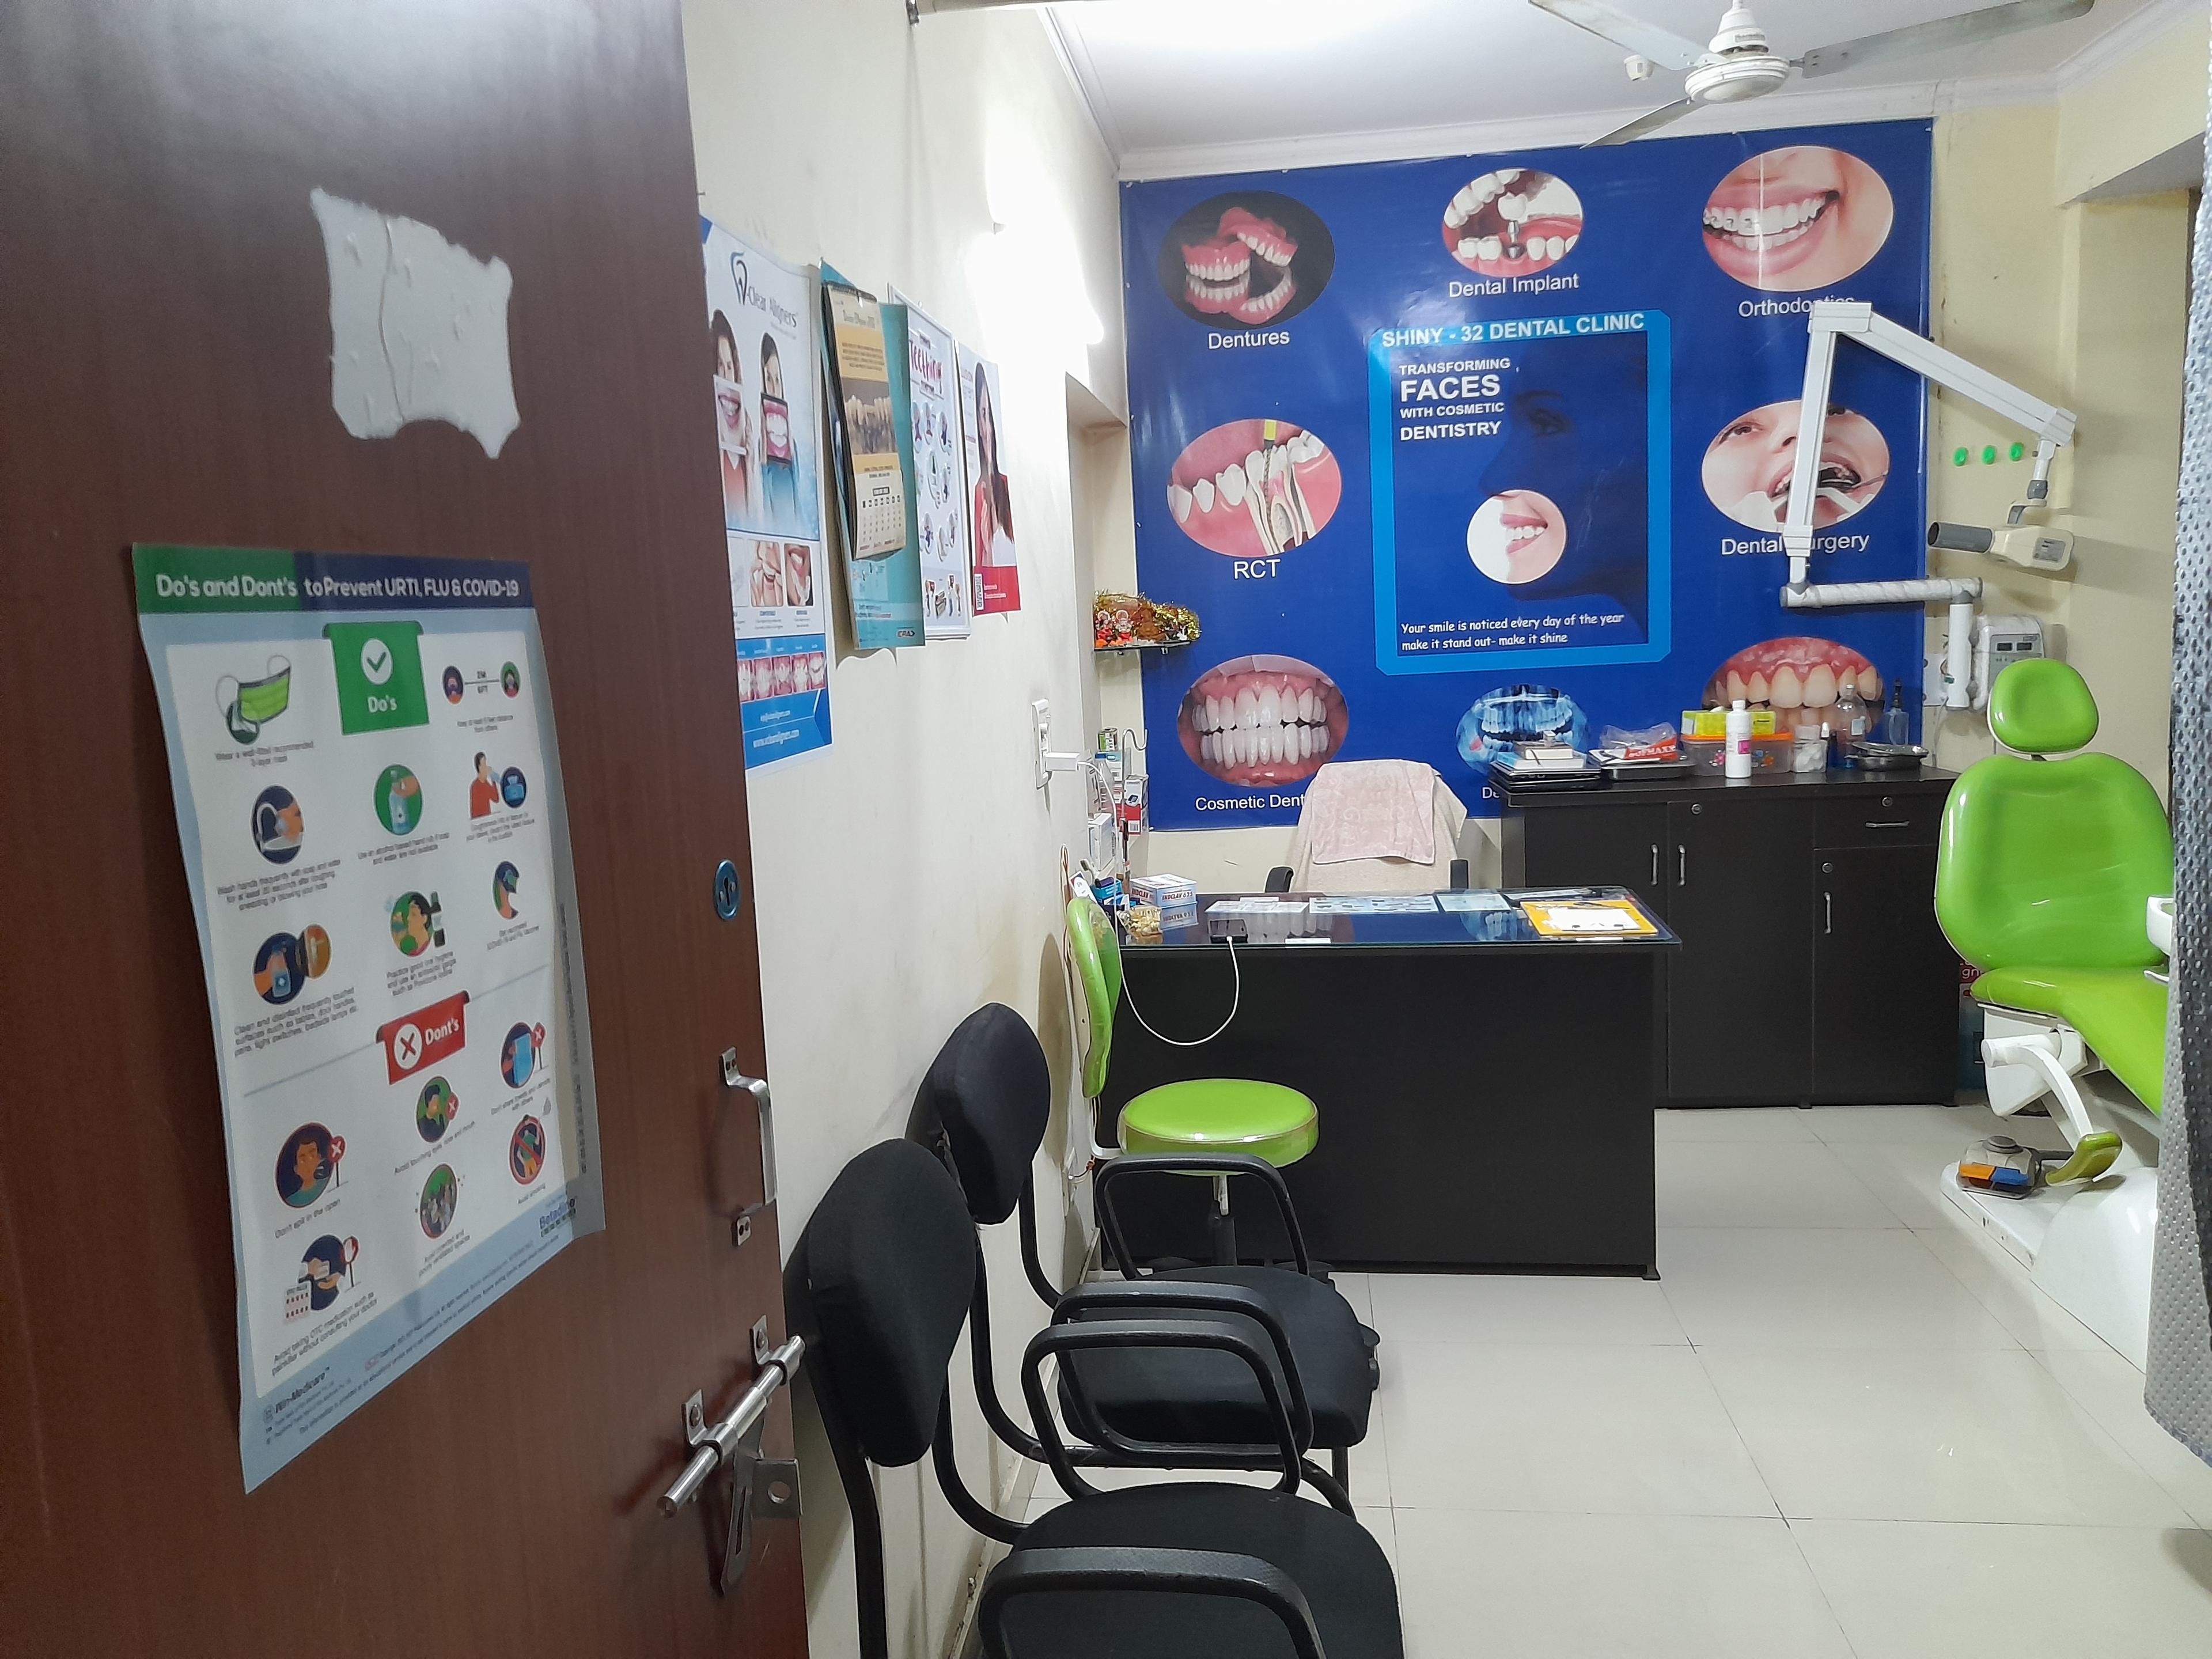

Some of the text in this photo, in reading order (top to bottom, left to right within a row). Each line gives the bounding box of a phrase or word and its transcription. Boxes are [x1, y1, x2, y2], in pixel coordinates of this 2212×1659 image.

[1449, 273, 1579, 298] Dental Implant
[1738, 294, 1855, 317] Orthodo
[1382, 327, 1443, 347] SHINY
[1461, 324, 1484, 342] 32
[1490, 319, 1571, 339] DENTAL
[1576, 313, 1645, 334] CLINIC
[1208, 331, 1290, 350] Dentures
[1399, 358, 1511, 376] TRANSFORMING
[1400, 374, 1501, 402] FACES
[1399, 402, 1505, 419] WITH COSMETIC
[1400, 421, 1502, 441] DENTISTRY
[1721, 535, 1870, 555] Dental rgery
[1233, 558, 1281, 579] RCT
[156, 573, 201, 597] Do's
[202, 575, 240, 597] and
[241, 575, 298, 597] Dont's
[423, 577, 450, 597] FLU
[451, 579, 462, 597] &
[463, 578, 519, 597] COVID-19
[1400, 613, 1624, 634] Your smile is noticed every day of the year
[1402, 632, 1568, 651] make it stand out- make it shine
[367, 695, 397, 713] Do's
[1195, 794, 1305, 811] Cosmetic Dent
[425, 1017, 460, 1046] Dont's
